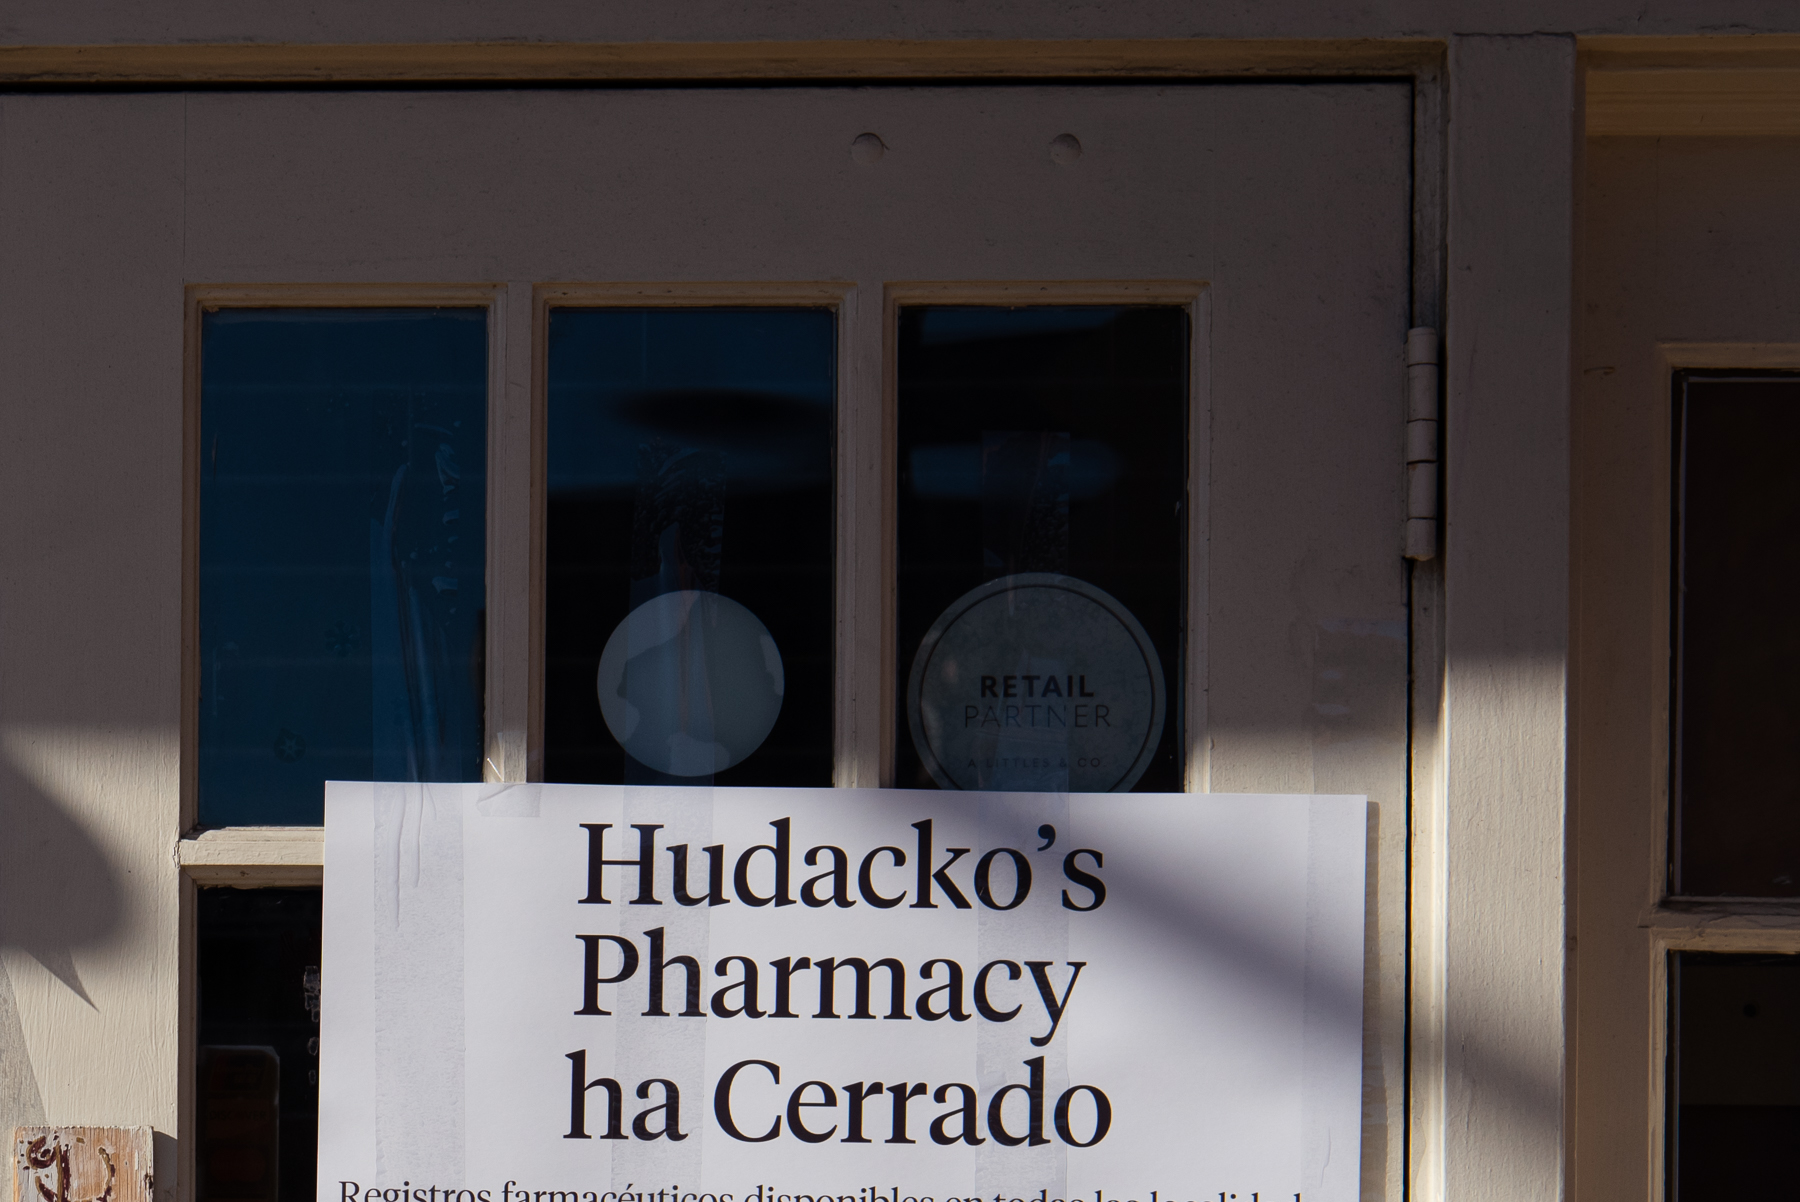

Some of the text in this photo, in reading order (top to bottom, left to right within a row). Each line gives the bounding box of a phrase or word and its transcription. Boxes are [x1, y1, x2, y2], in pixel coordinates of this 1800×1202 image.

[981, 675, 1094, 697] RETAIL
[965, 705, 1111, 728] PARTNER
[986, 758, 1050, 768] LITTLES
[578, 817, 1106, 912] Hudacko's
[574, 927, 1087, 1047] Pharmacy
[563, 1049, 1112, 1147] ha Cerrado
